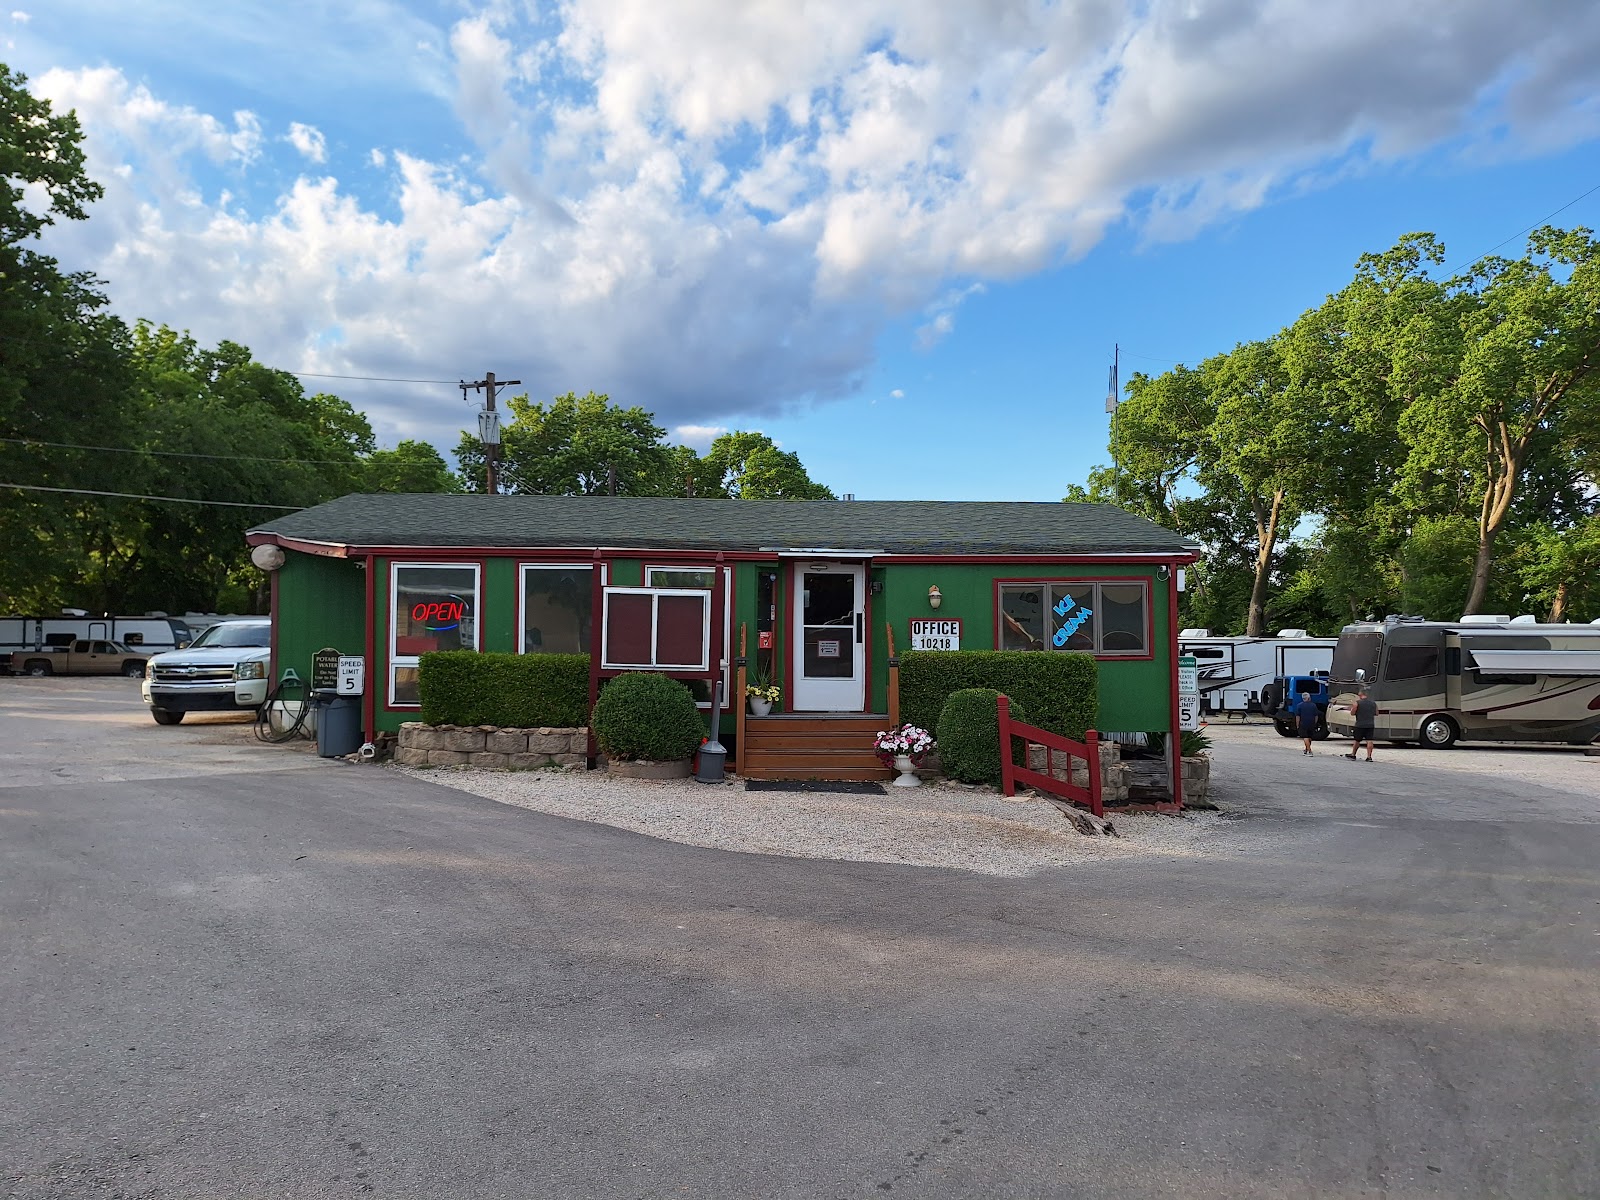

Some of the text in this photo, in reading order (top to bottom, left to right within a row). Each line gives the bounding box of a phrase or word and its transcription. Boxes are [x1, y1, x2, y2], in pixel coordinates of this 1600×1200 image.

[412, 602, 464, 620] OPEN
[1053, 594, 1076, 617] ICE
[913, 621, 957, 635] OFFICE
[1053, 606, 1093, 646] CREAM
[920, 638, 951, 649] 10218
[345, 677, 355, 690] 5
[1181, 708, 1192, 722] 5
